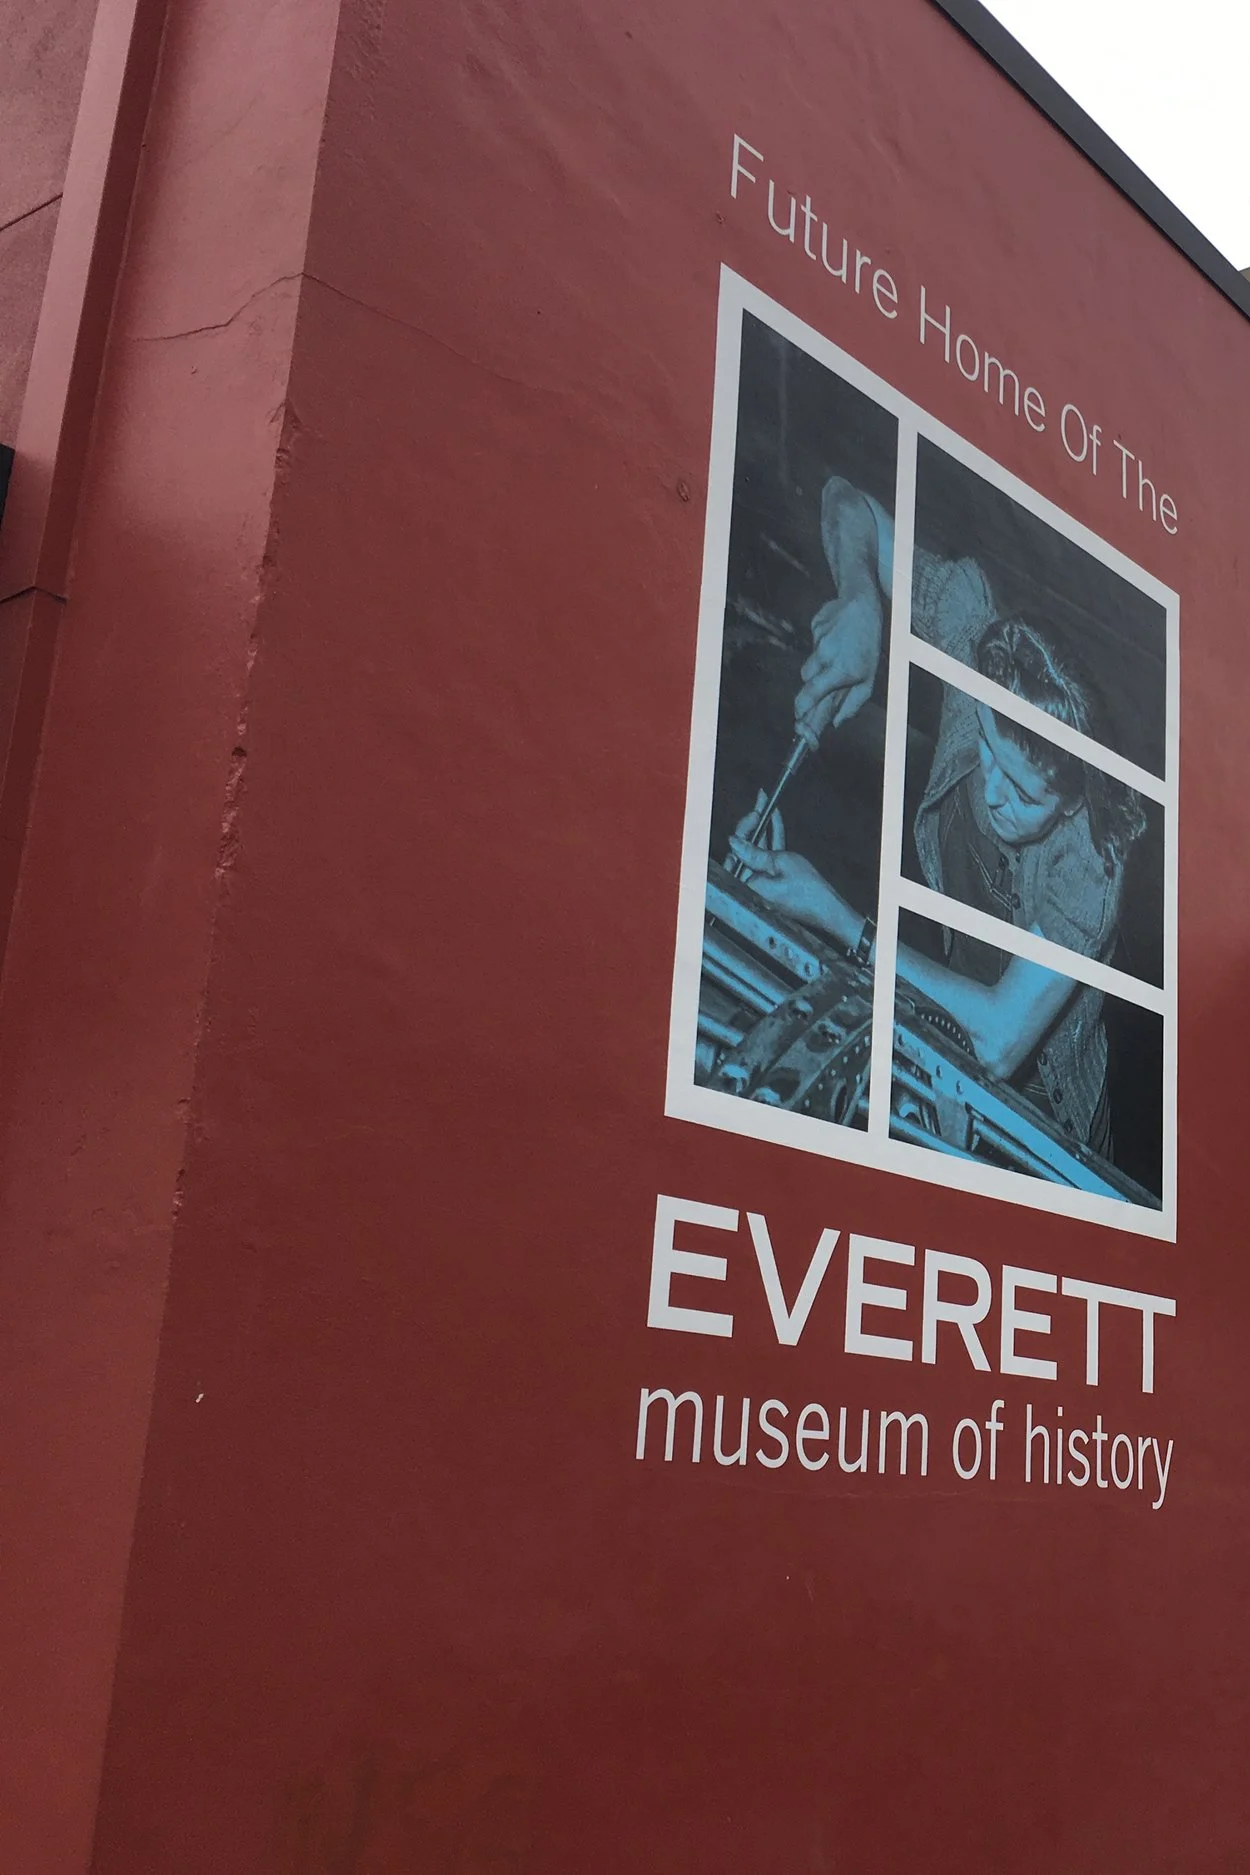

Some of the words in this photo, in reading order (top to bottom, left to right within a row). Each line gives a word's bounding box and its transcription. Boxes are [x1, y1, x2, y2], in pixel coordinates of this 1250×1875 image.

[731, 133, 898, 319] Future
[919, 286, 1046, 432] Home
[1060, 404, 1102, 475] Of
[1113, 439, 1178, 534] The
[647, 1194, 1177, 1394] EVERETT
[635, 1387, 928, 1477] museum
[952, 1399, 1005, 1481] of
[1025, 1403, 1174, 1510] history
